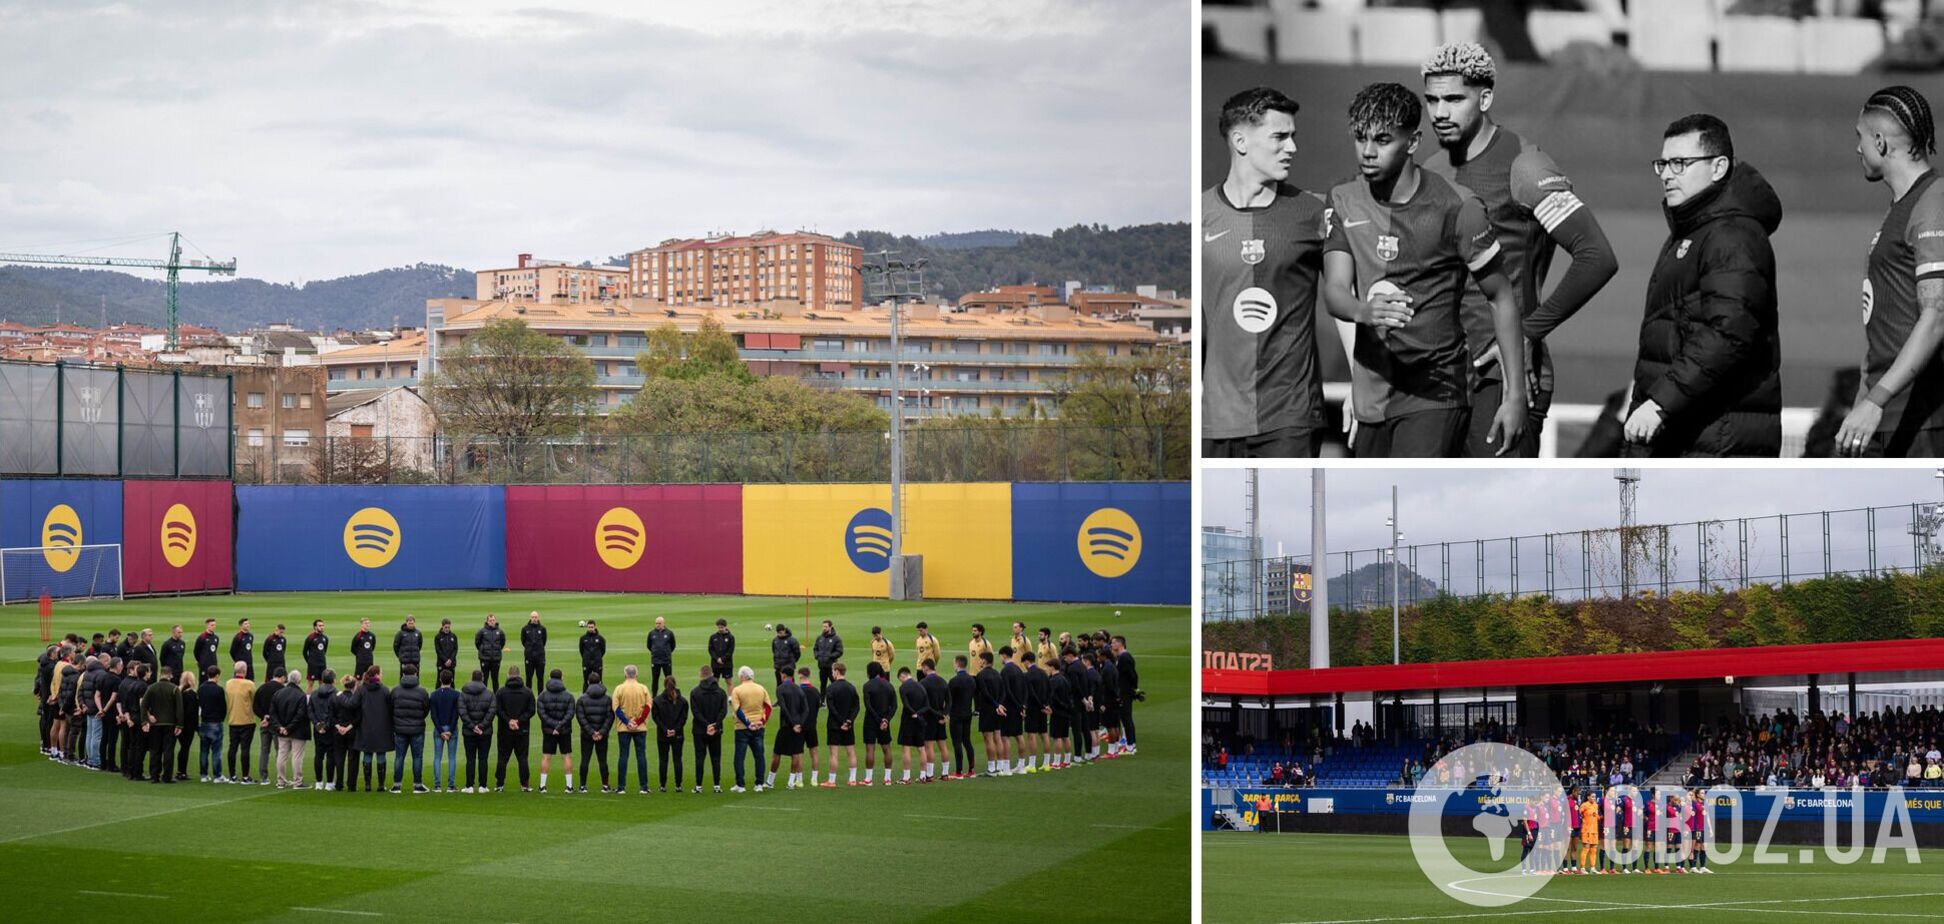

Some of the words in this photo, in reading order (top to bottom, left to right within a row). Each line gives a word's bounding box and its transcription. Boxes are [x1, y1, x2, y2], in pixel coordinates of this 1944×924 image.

[1403, 795, 1437, 803] BARCELONA
[1797, 799, 1808, 808] FC
[1808, 799, 1854, 808] BARCELONA
[1905, 797, 1923, 809] MÉS
[1924, 800, 1942, 811] QUE
